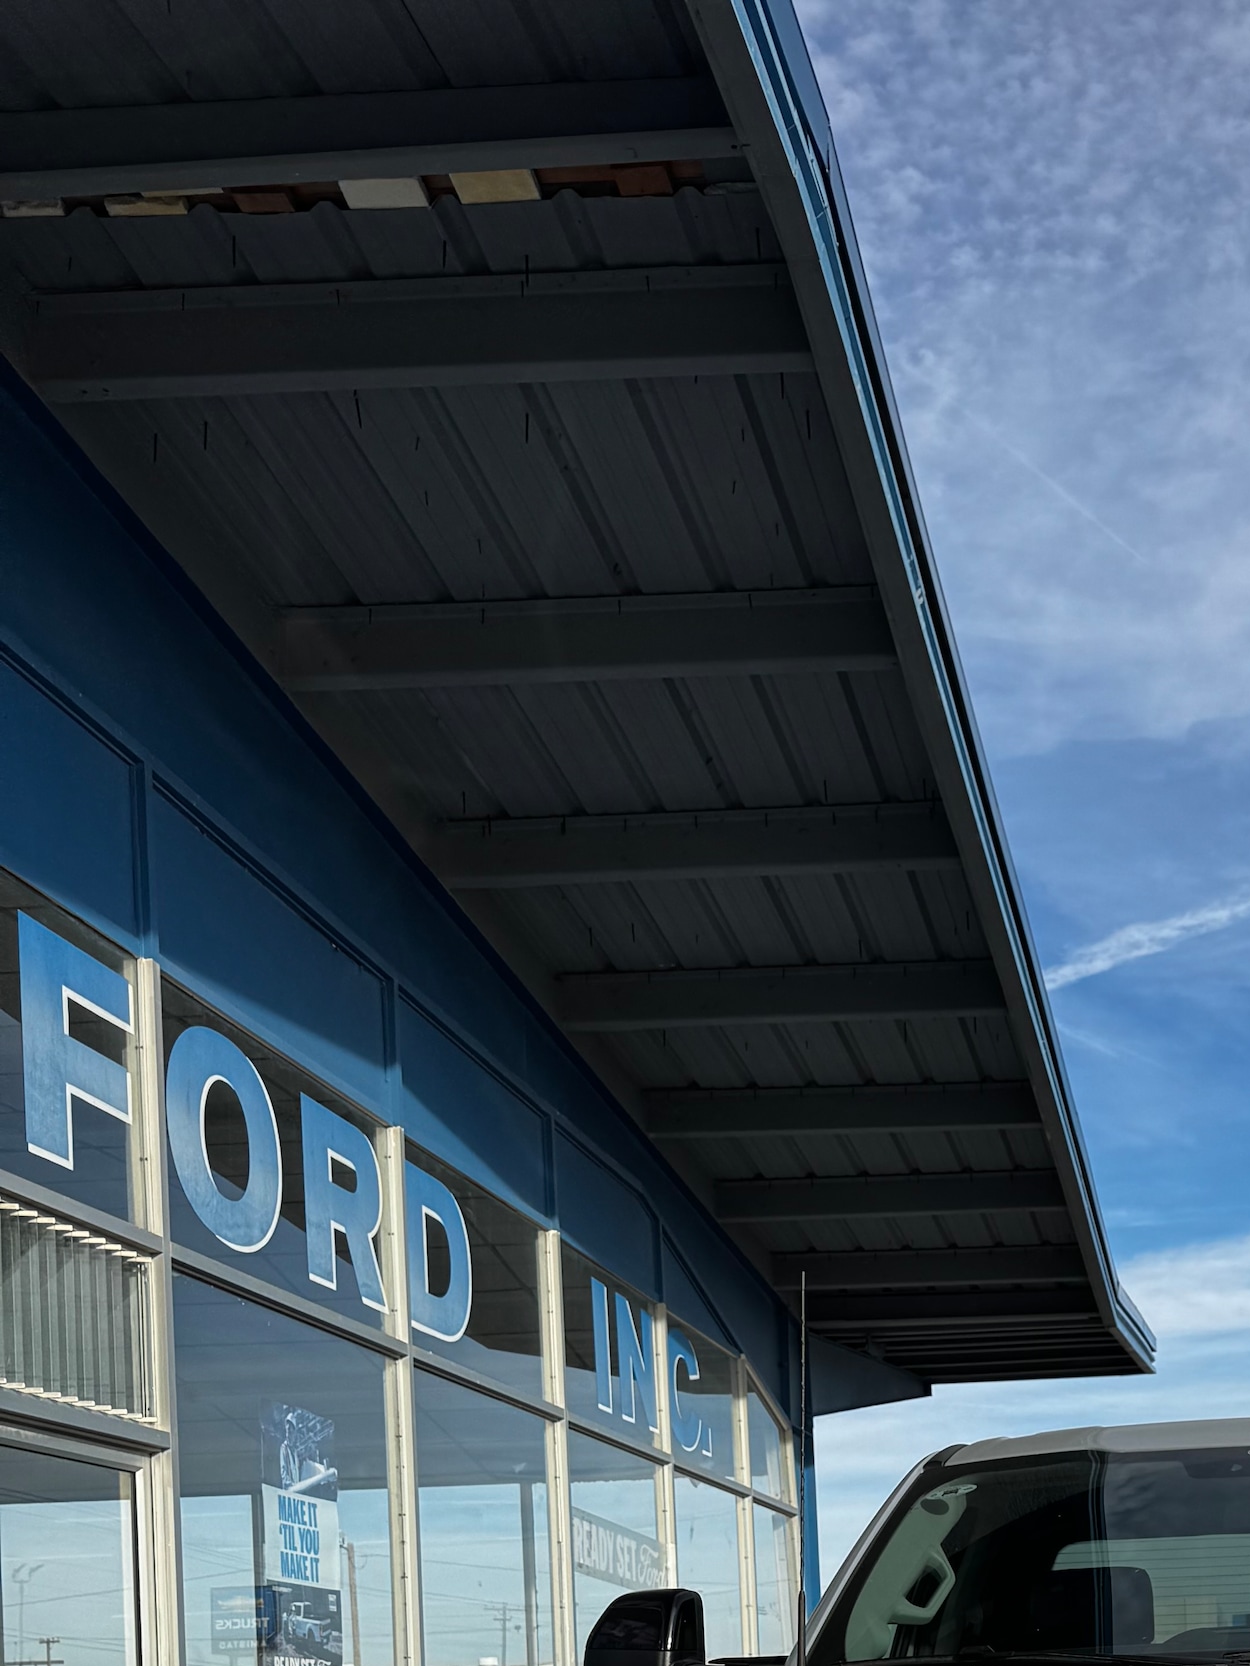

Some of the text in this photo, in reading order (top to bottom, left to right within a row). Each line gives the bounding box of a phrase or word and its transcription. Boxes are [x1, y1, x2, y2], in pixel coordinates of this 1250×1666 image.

[17, 910, 713, 1457] FORD INC.
[278, 1494, 318, 1528] MAKE IT
[298, 1527, 320, 1556] YOU
[572, 1516, 668, 1589] READY SET Ford
[280, 1551, 320, 1583] MAKE IT
